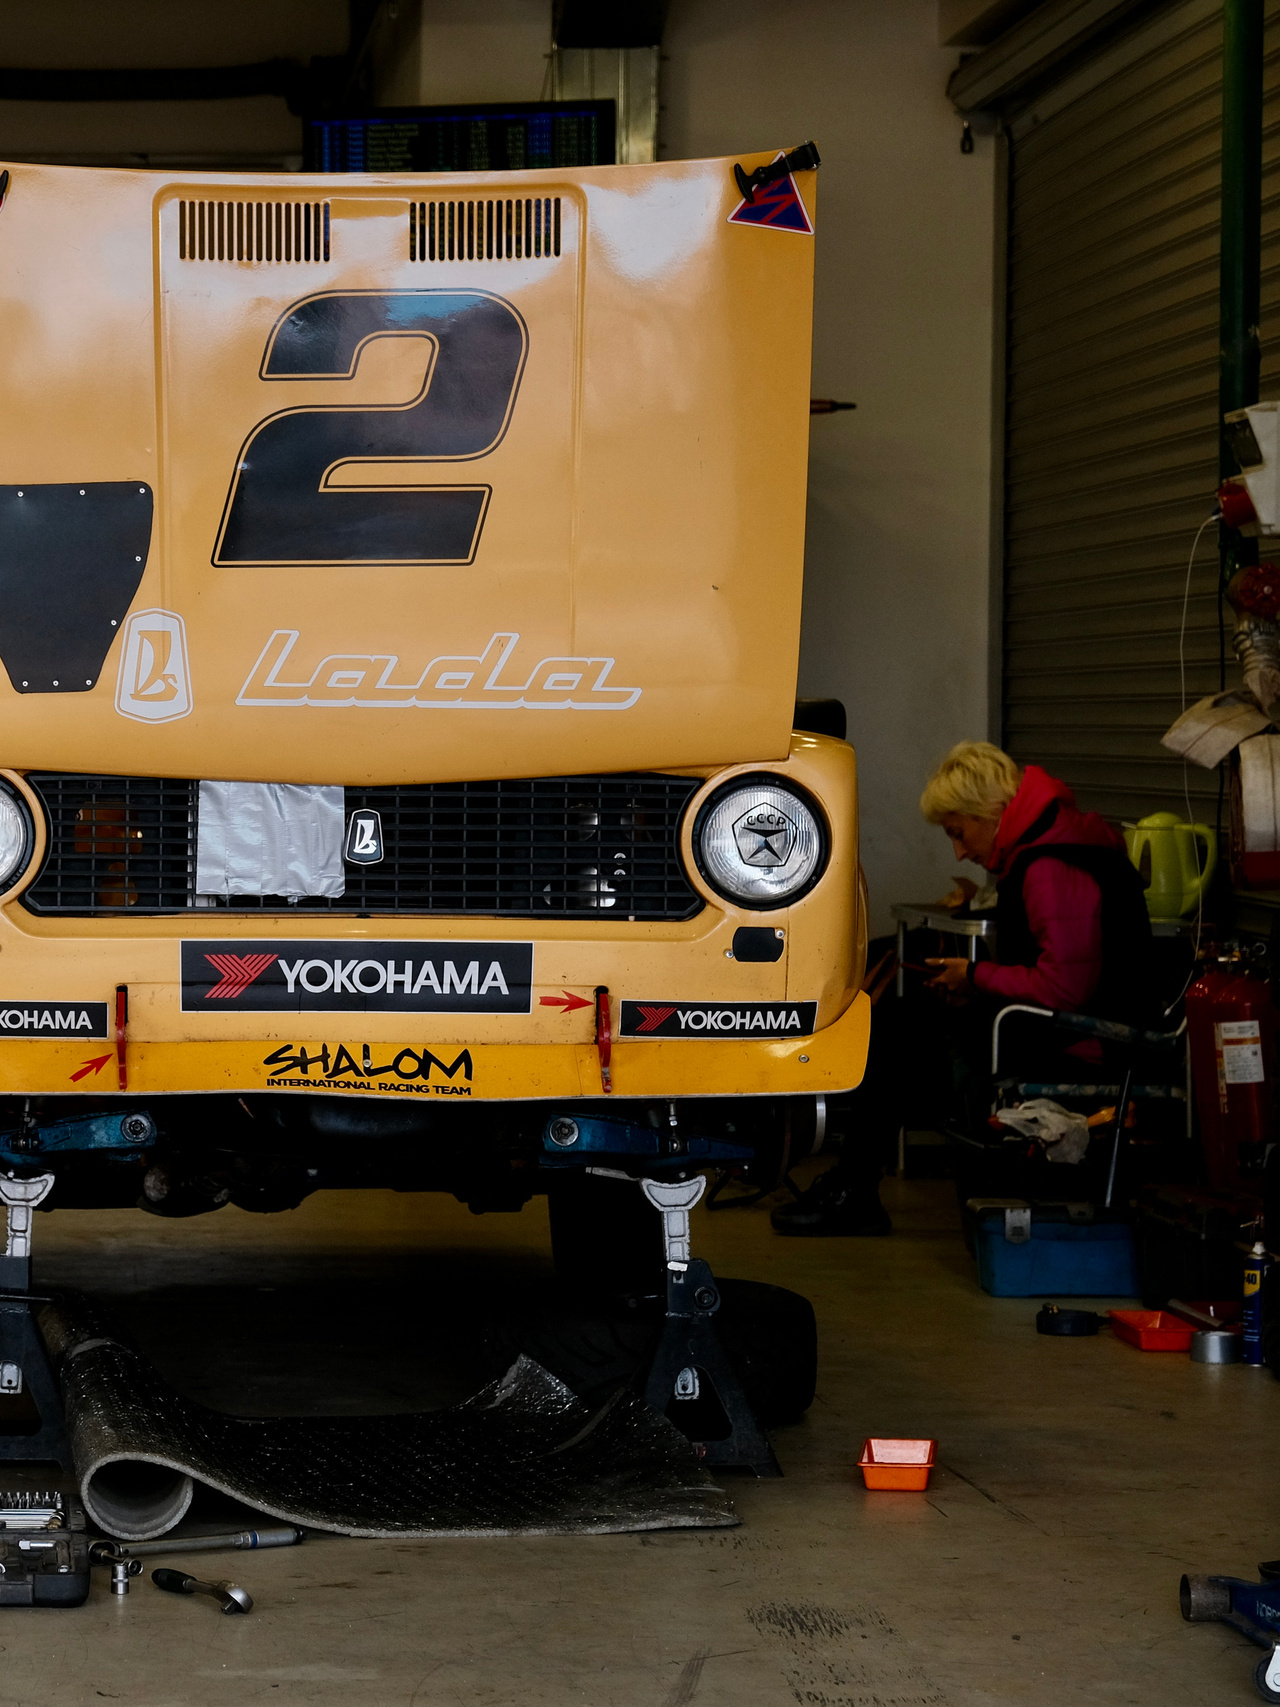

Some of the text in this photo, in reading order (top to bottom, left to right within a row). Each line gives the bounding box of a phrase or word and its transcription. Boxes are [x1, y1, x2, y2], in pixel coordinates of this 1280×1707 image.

[210, 287, 530, 568] 2
[235, 629, 642, 710] Lada
[277, 959, 509, 995] YOKOHAMA
[677, 1010, 801, 1030] YOKOHAMA
[263, 1042, 473, 1081] SHALOM
[267, 1078, 472, 1096] INTERNATIONAL RACING TEAM
